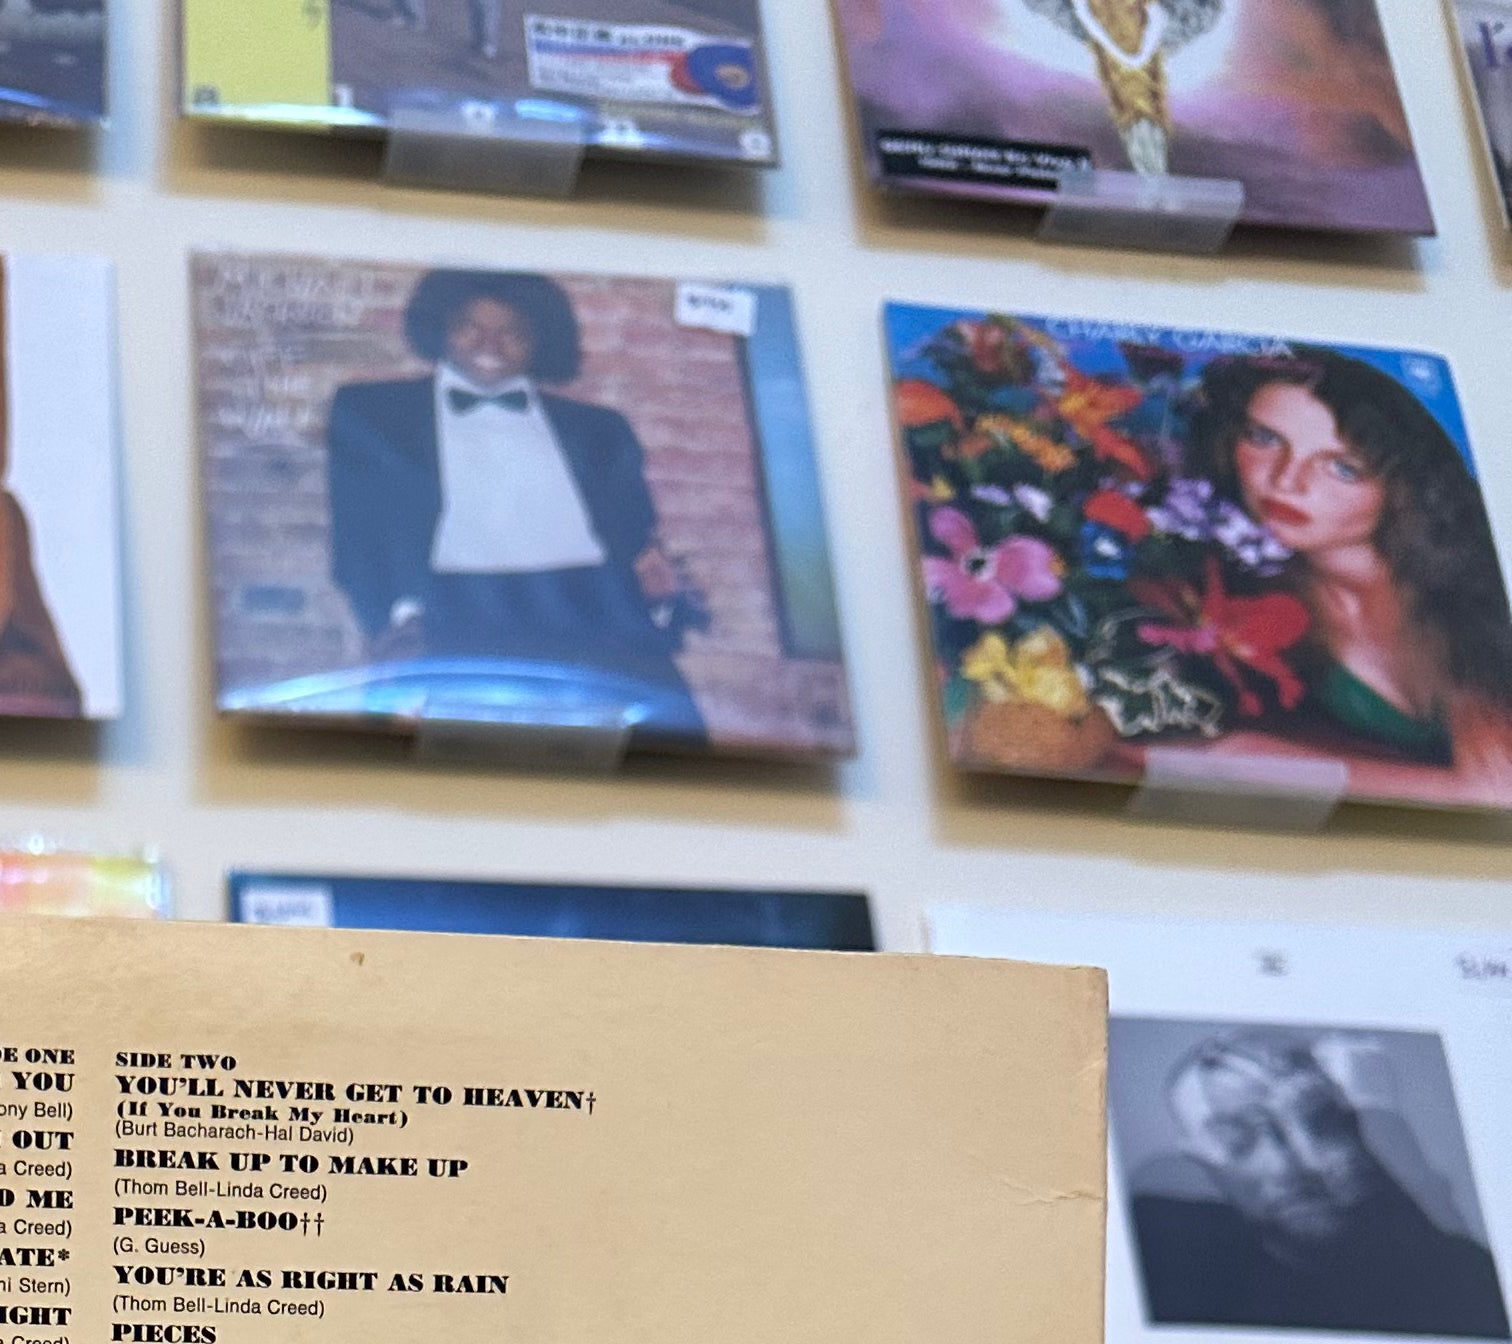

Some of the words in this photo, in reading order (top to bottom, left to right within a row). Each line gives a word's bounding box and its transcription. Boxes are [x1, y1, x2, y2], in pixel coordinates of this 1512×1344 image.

[25, 1048, 74, 1065] ONE
[115, 1052, 172, 1068] SIDE
[180, 1054, 236, 1071] TWO
[11, 1071, 76, 1092] YOU
[114, 1074, 224, 1097] YOU'LL
[232, 1078, 336, 1101] NEVER
[346, 1083, 402, 1103] GET
[413, 1085, 452, 1105] TO
[34, 1102, 72, 1122] Bell)
[117, 1100, 148, 1118] (If
[156, 1102, 201, 1118] You
[211, 1104, 279, 1121] Break
[288, 1106, 324, 1124] My
[333, 1108, 408, 1127] Heart)
[12, 1130, 74, 1150] OUT
[116, 1120, 157, 1139] (Burt
[164, 1122, 292, 1141] Bacharach-Hal
[300, 1126, 354, 1145] David)
[113, 1148, 220, 1170] BREAK
[229, 1152, 271, 1172] UP
[279, 1154, 319, 1173] TO
[328, 1156, 418, 1176] MAKE
[426, 1158, 468, 1178] UP
[26, 1189, 73, 1209] ME
[114, 1236, 138, 1256] (G.
[145, 1238, 205, 1258] Guess)
[19, 1277, 70, 1297] Stern)
[112, 1265, 226, 1287] YOU'RE
[232, 1270, 272, 1288] AS
[280, 1270, 378, 1290] RIGHT
[387, 1274, 424, 1292] AS
[432, 1274, 510, 1294] RAIN
[110, 1323, 216, 1344] PIECES
